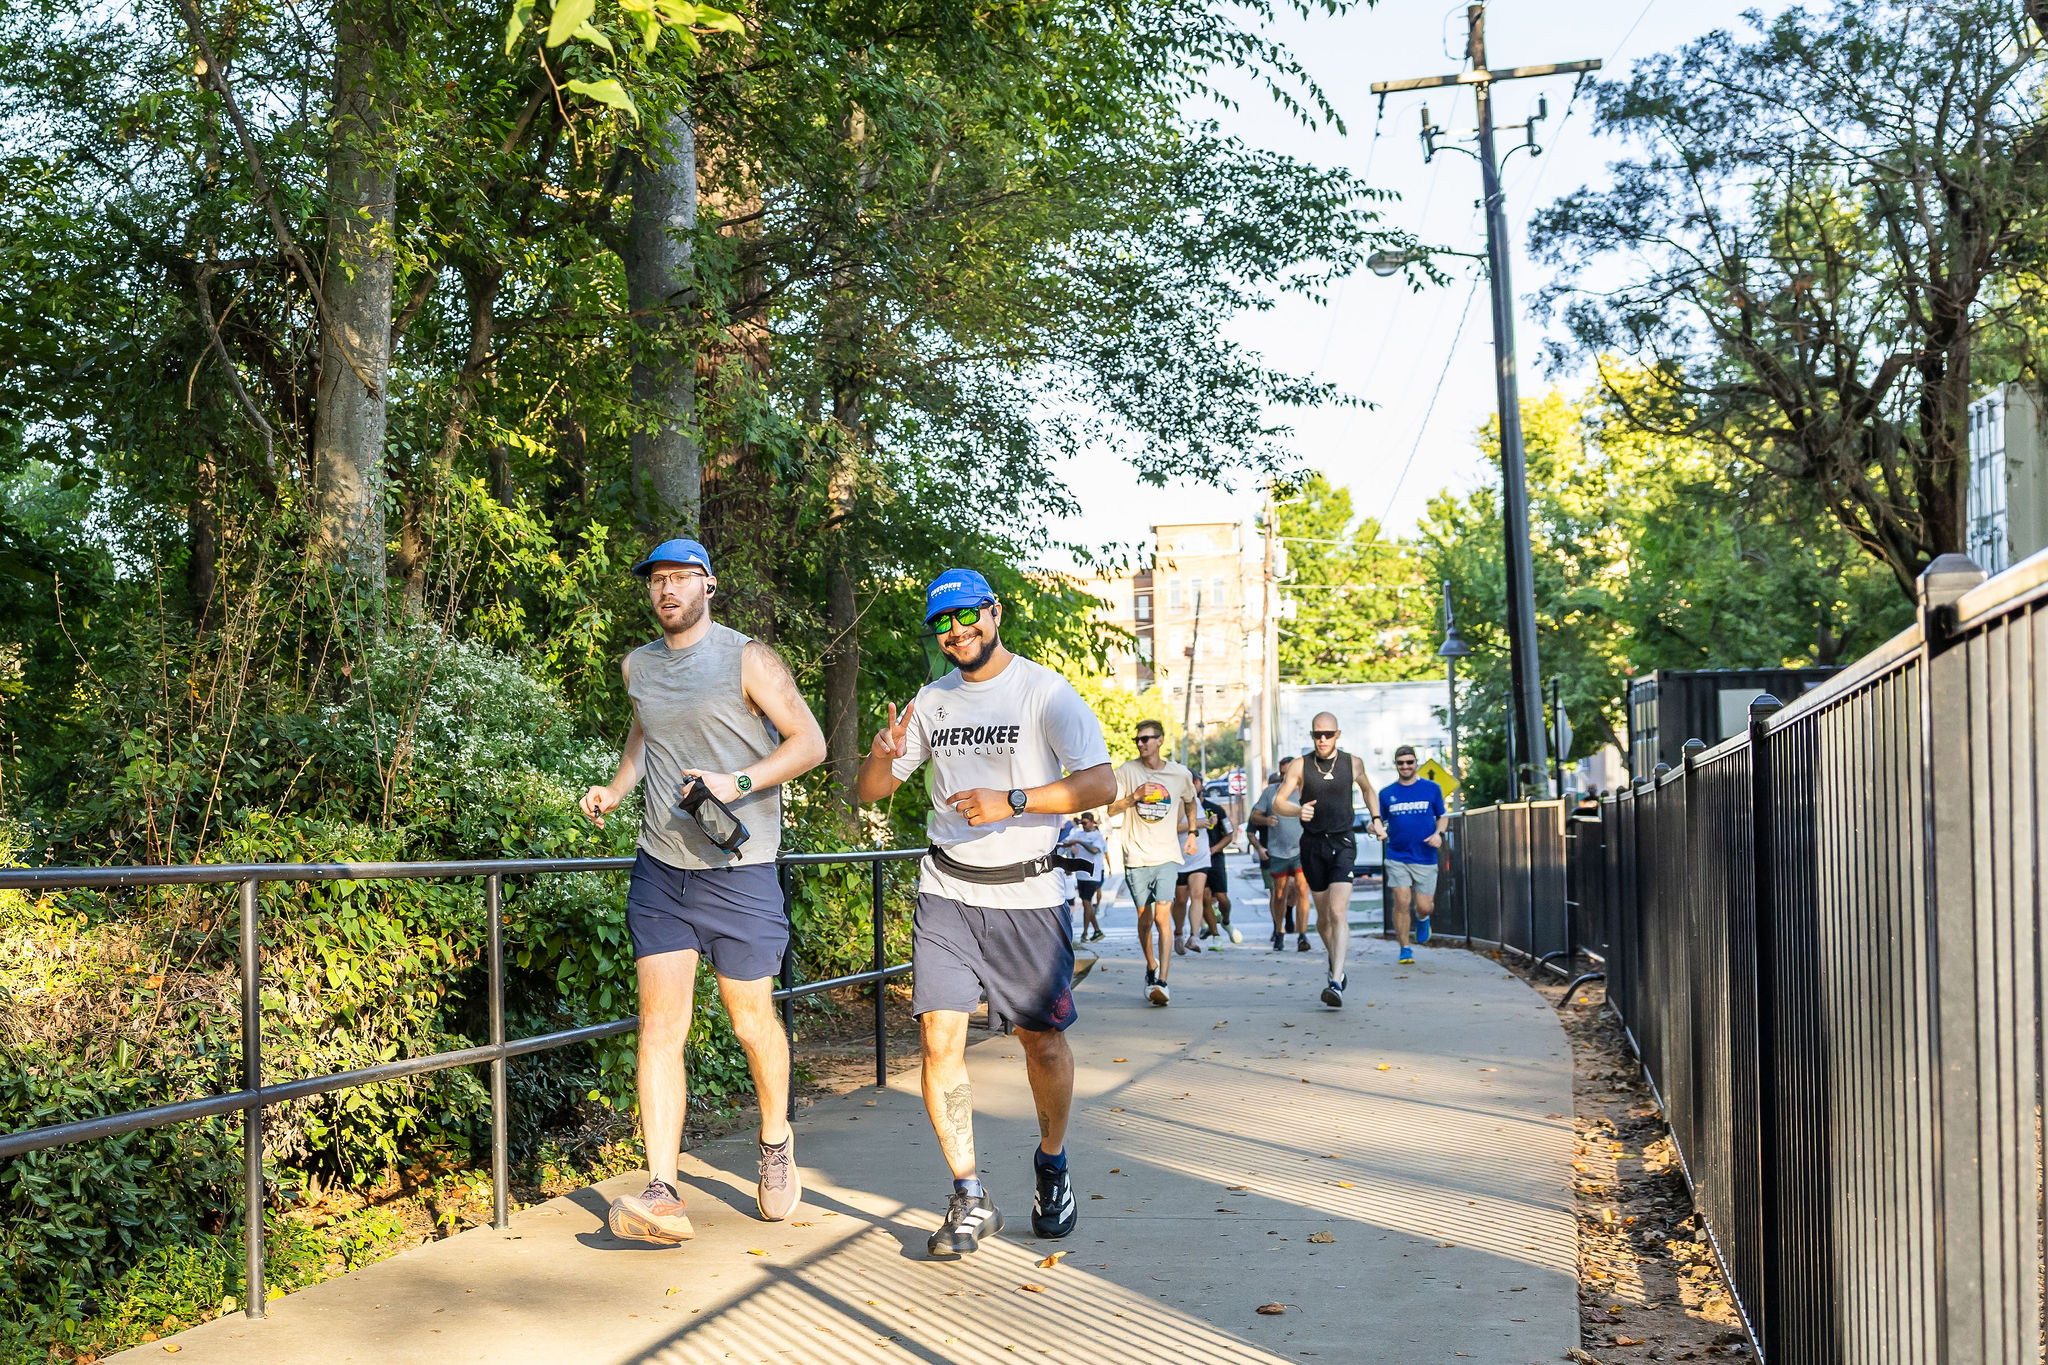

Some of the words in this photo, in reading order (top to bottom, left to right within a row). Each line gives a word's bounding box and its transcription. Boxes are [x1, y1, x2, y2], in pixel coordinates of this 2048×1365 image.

[930, 725, 1020, 748] CHEROKEE
[934, 748, 966, 758] RUN
[974, 747, 1015, 755] CLUB
